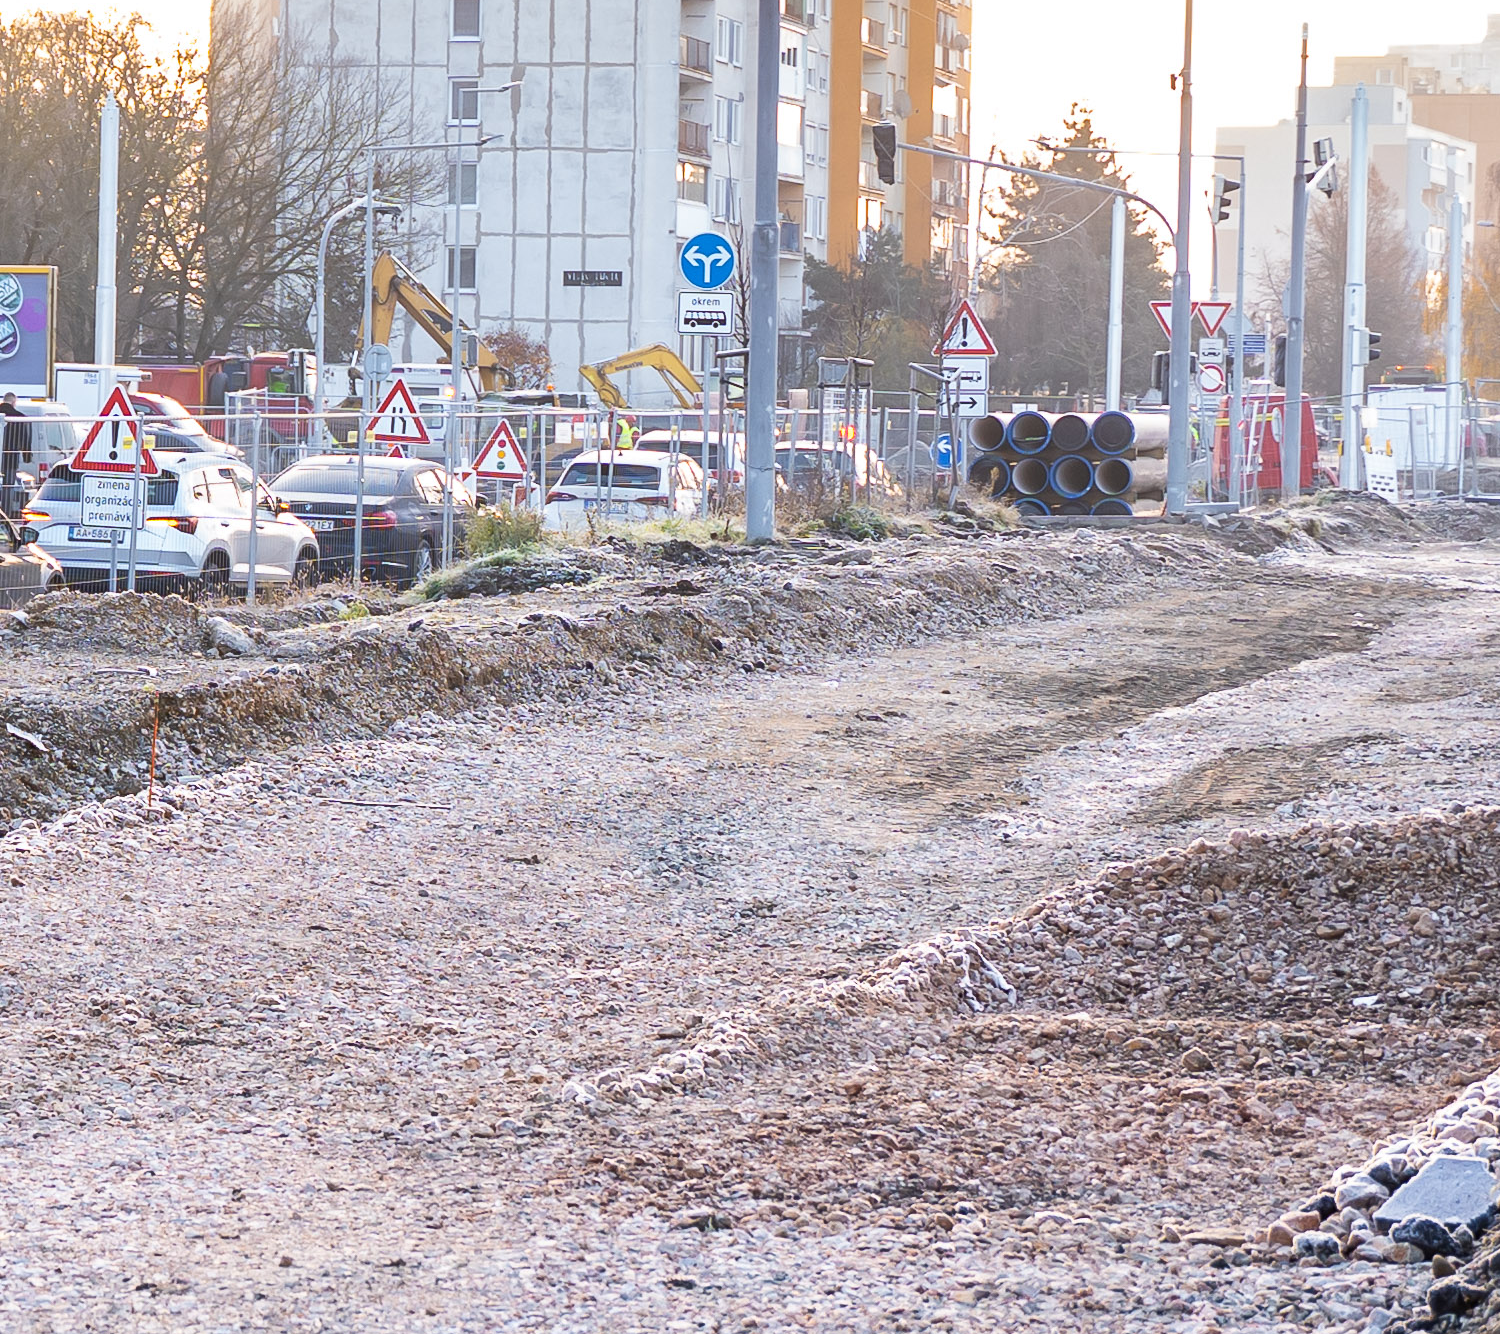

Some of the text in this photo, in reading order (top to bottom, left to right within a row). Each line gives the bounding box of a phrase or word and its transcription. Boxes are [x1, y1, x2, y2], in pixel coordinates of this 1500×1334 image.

[691, 296, 721, 307] okrem
[97, 480, 130, 491] zmena
[85, 495, 142, 508] organizáce
[88, 510, 132, 523] premávk
